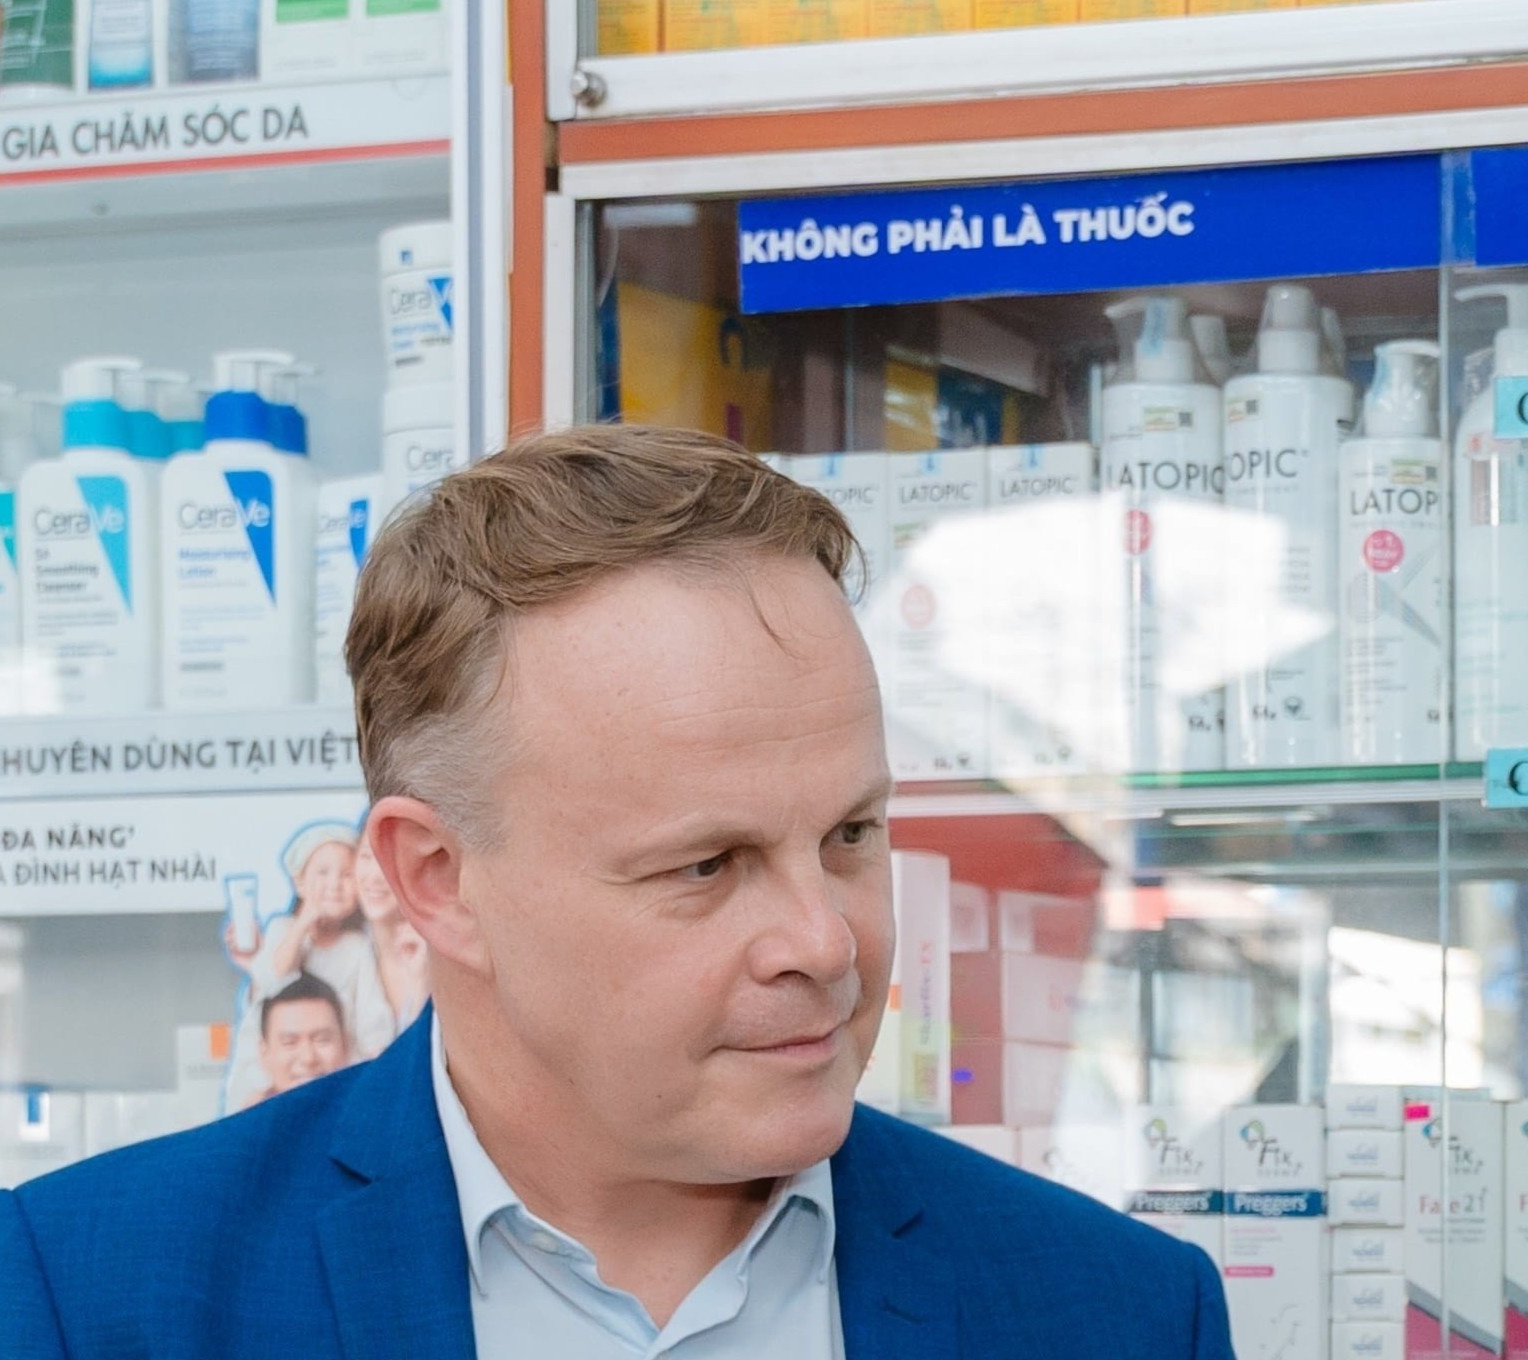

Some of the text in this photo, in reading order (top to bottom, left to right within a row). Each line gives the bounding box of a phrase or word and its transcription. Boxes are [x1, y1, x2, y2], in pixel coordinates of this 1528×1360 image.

[2, 124, 60, 160] GIA
[183, 104, 251, 148] SÓC
[263, 104, 311, 141] DA
[742, 190, 1195, 266] KHÔNG PHẢI LÀ THUỐC
[123, 735, 218, 773] DÙNG
[227, 737, 275, 779] TẠI
[14, 857, 83, 886] ĐÌNH
